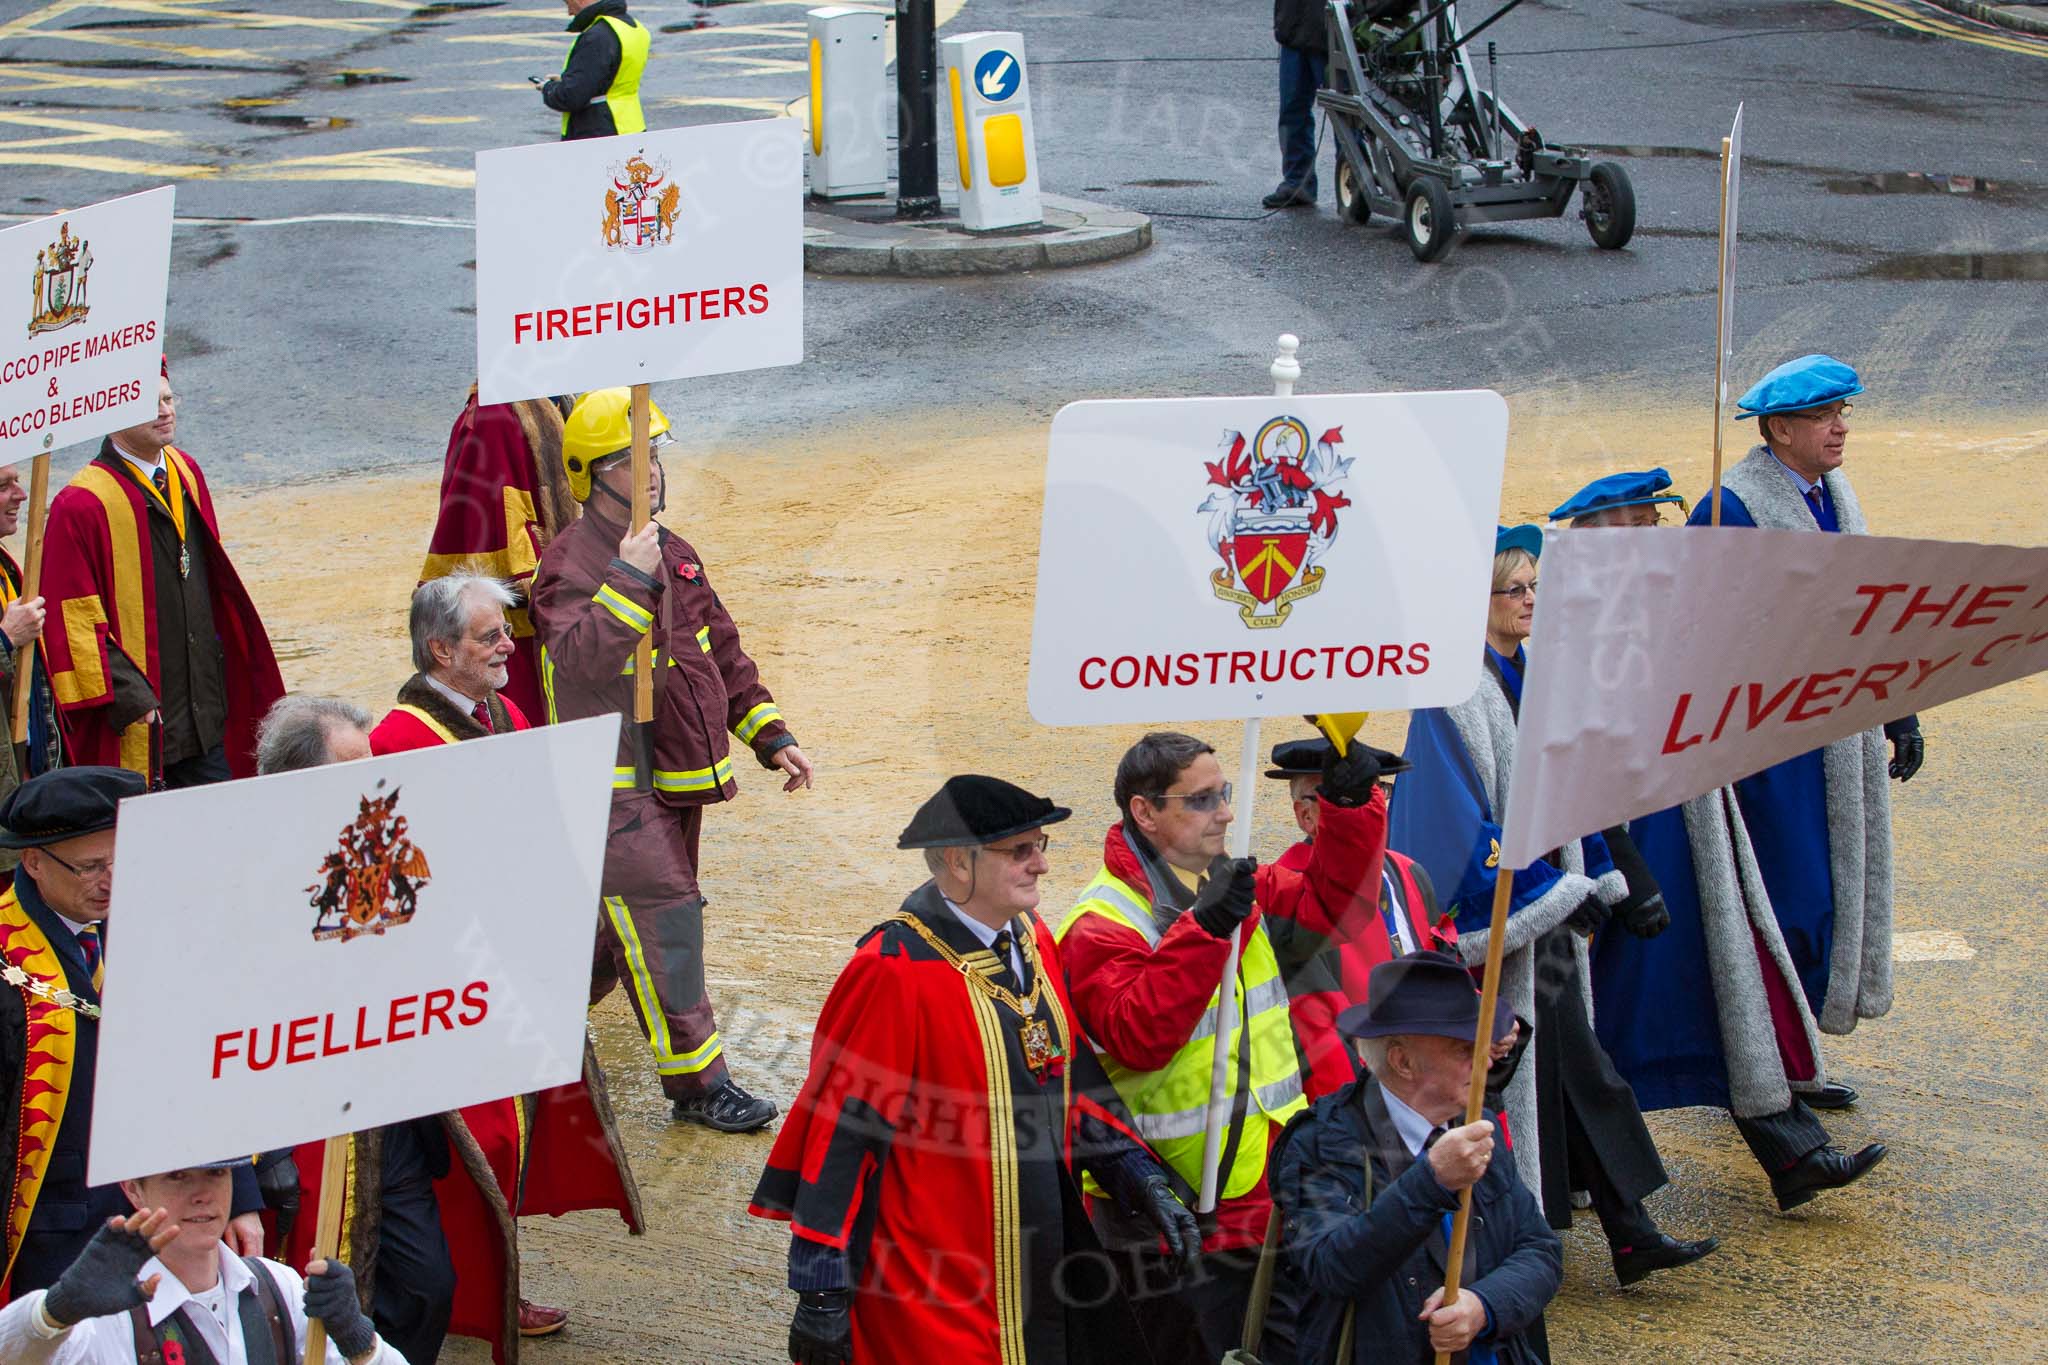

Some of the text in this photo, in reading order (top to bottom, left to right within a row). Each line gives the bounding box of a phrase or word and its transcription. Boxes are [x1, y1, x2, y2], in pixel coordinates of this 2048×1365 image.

[514, 284, 768, 344] FIREFIGHTERS
[43, 341, 80, 372] PIPE
[85, 320, 156, 359] MAKERS
[48, 377, 58, 397] &
[50, 380, 140, 425] BLENDERS
[1850, 583, 2028, 637] THE
[1079, 643, 1429, 690] CONSTRUCTORS
[1662, 652, 1961, 754] LIVERY
[212, 981, 489, 1079] FUELLERS
